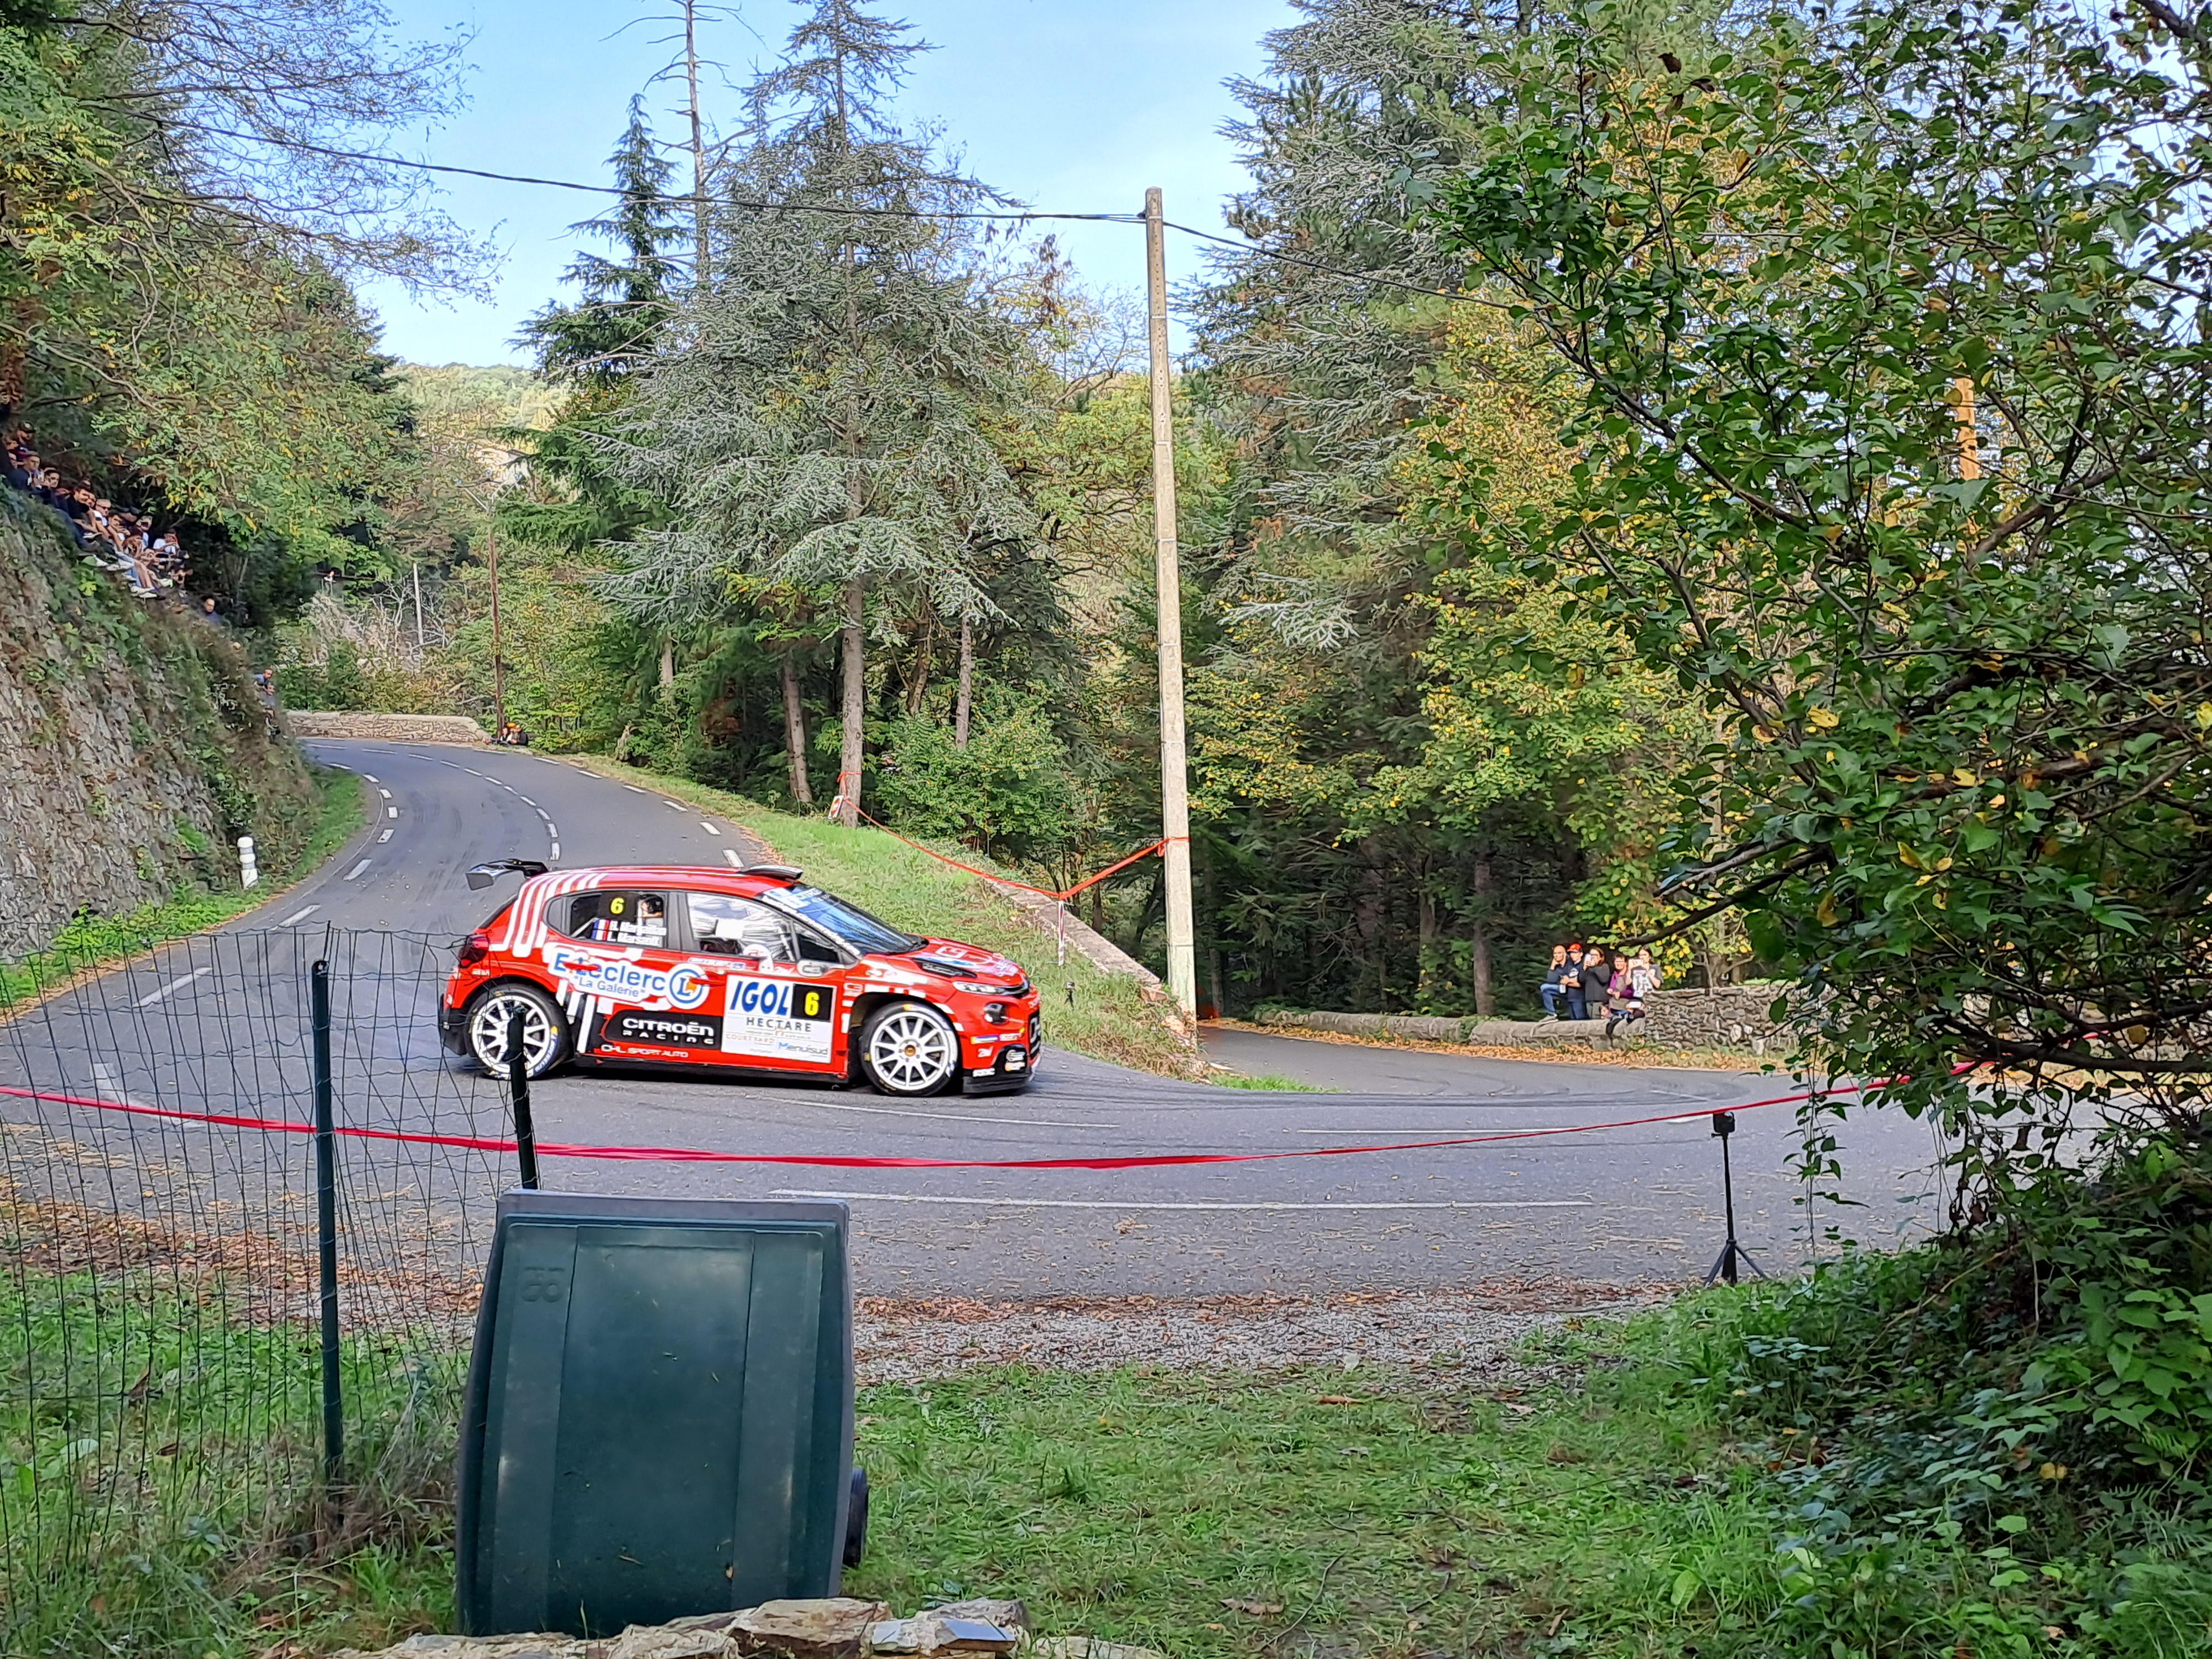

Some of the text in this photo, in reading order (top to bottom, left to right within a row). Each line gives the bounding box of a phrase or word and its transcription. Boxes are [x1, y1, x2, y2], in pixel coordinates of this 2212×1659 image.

[610, 896, 625, 914] 6
[729, 980, 820, 1016] IGOL 6
[746, 1017, 812, 1032] HECTARE
[778, 1042, 828, 1056] Menuisud
